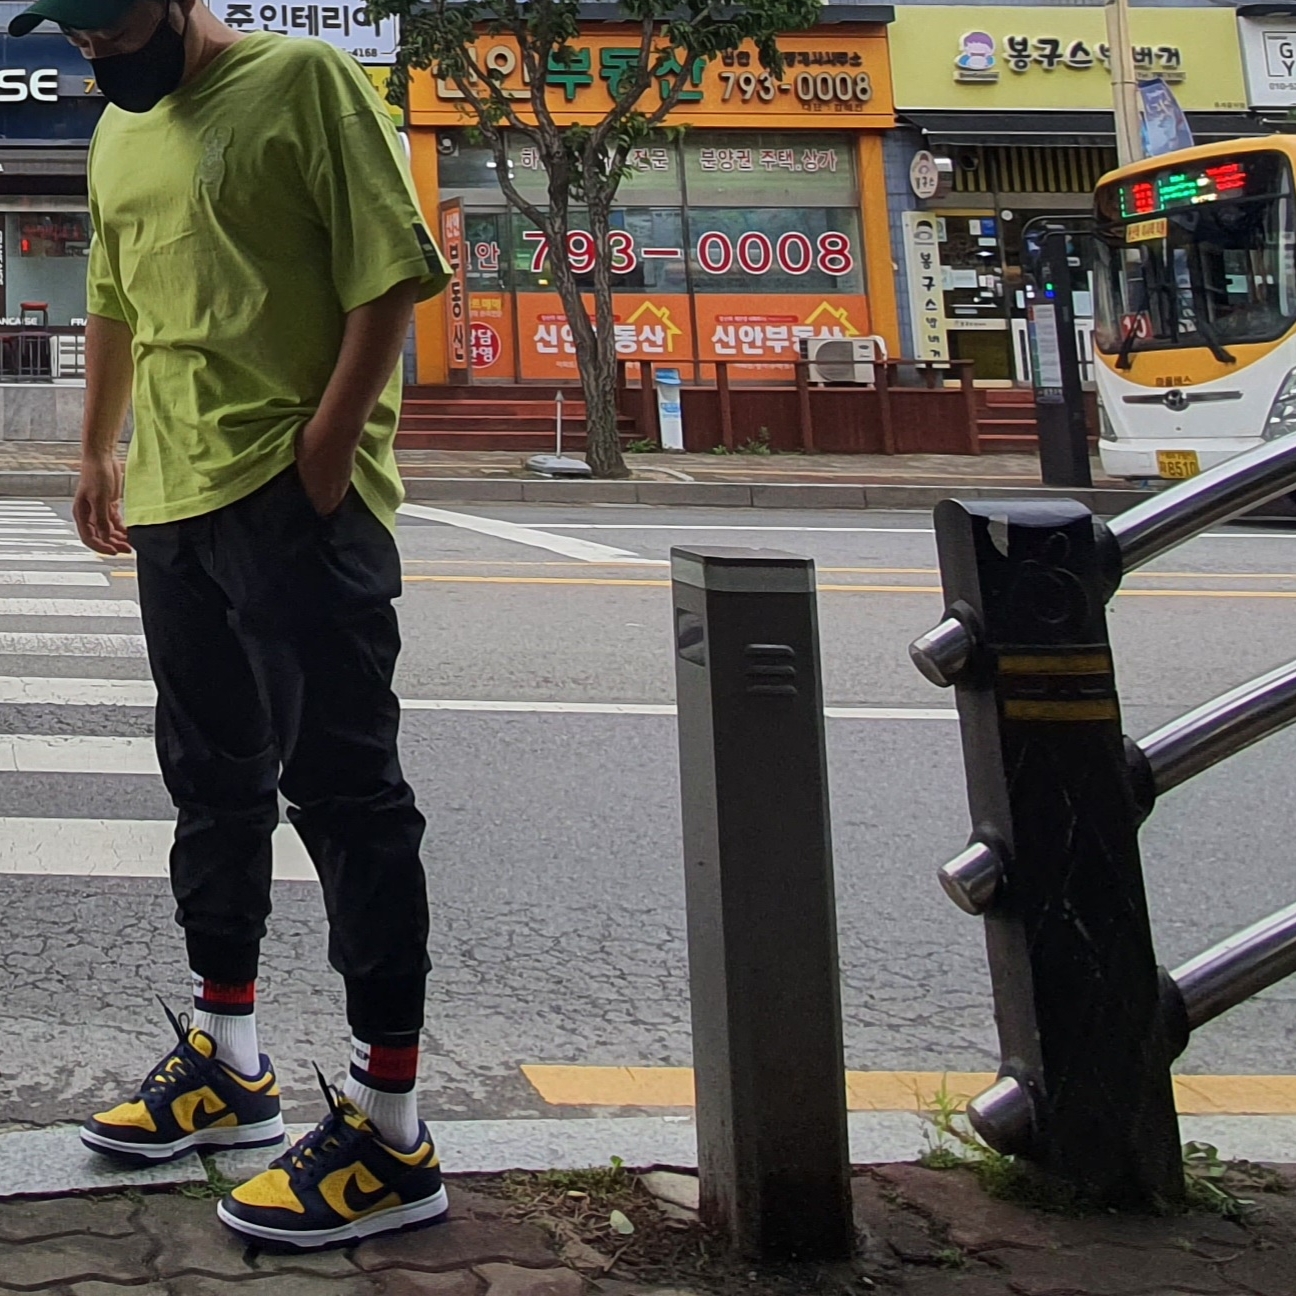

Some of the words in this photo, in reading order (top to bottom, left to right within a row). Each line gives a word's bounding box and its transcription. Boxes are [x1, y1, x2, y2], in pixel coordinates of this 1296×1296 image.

[719, 71, 872, 102] 793-0008
[701, 149, 753, 171] 분양권
[522, 230, 853, 276] 793-0008
